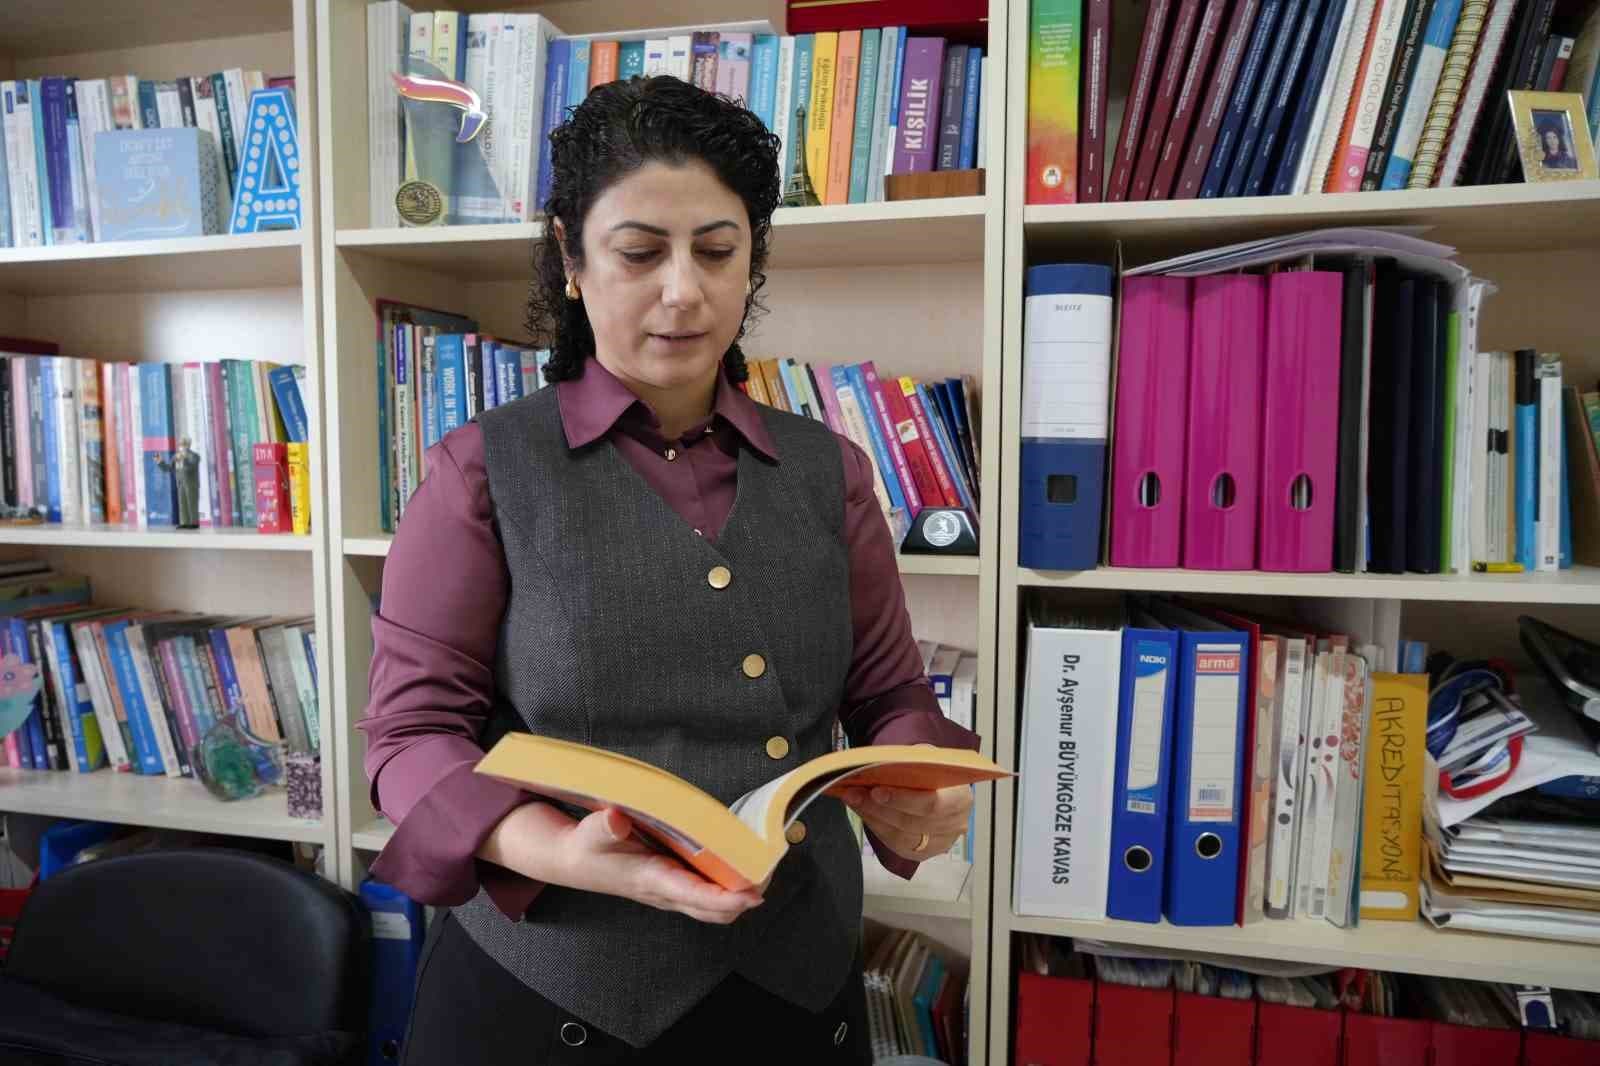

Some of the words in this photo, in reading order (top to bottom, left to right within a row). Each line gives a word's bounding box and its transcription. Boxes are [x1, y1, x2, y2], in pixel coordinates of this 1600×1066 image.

[1359, 37, 1392, 134] PSYCHOLOGY
[902, 77, 930, 150] KİŞİLİK
[441, 367, 454, 396] WORK
[443, 398, 454, 408] IN
[444, 411, 455, 428] THE
[1062, 653, 1081, 674] Dr.
[1199, 657, 1235, 670] arma
[1057, 677, 1081, 737] Ayşenur
[1054, 741, 1077, 833] BÜYÜKGÖZE
[1052, 837, 1072, 885] KAVAS
